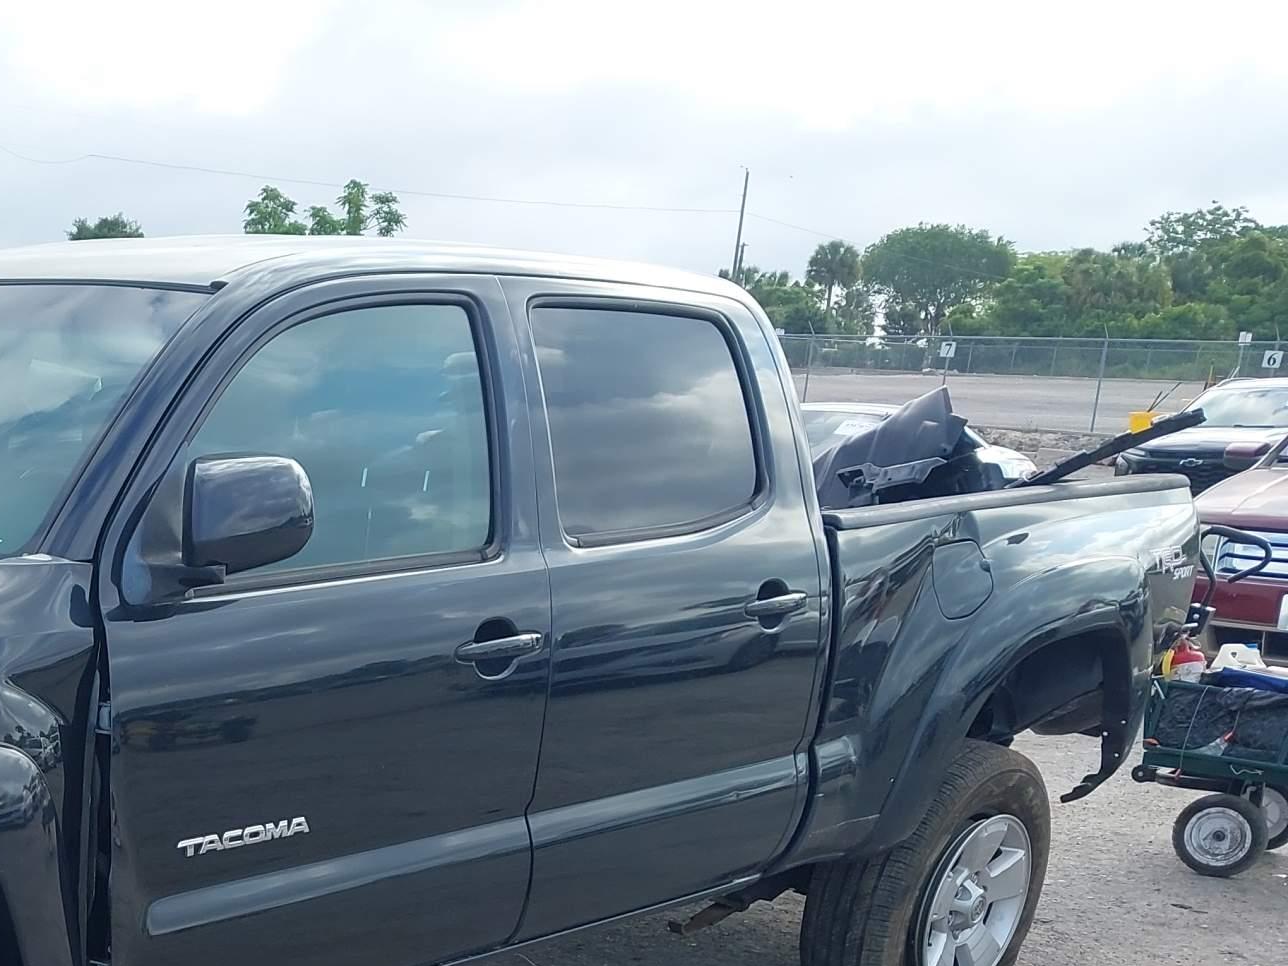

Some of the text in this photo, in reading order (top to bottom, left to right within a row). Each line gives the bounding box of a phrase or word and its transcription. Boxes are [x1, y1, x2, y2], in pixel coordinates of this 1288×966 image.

[944, 343, 953, 356] 7
[1267, 352, 1279, 366] 6
[1172, 564, 1195, 580] SPORT
[176, 815, 310, 858] TACOMA
